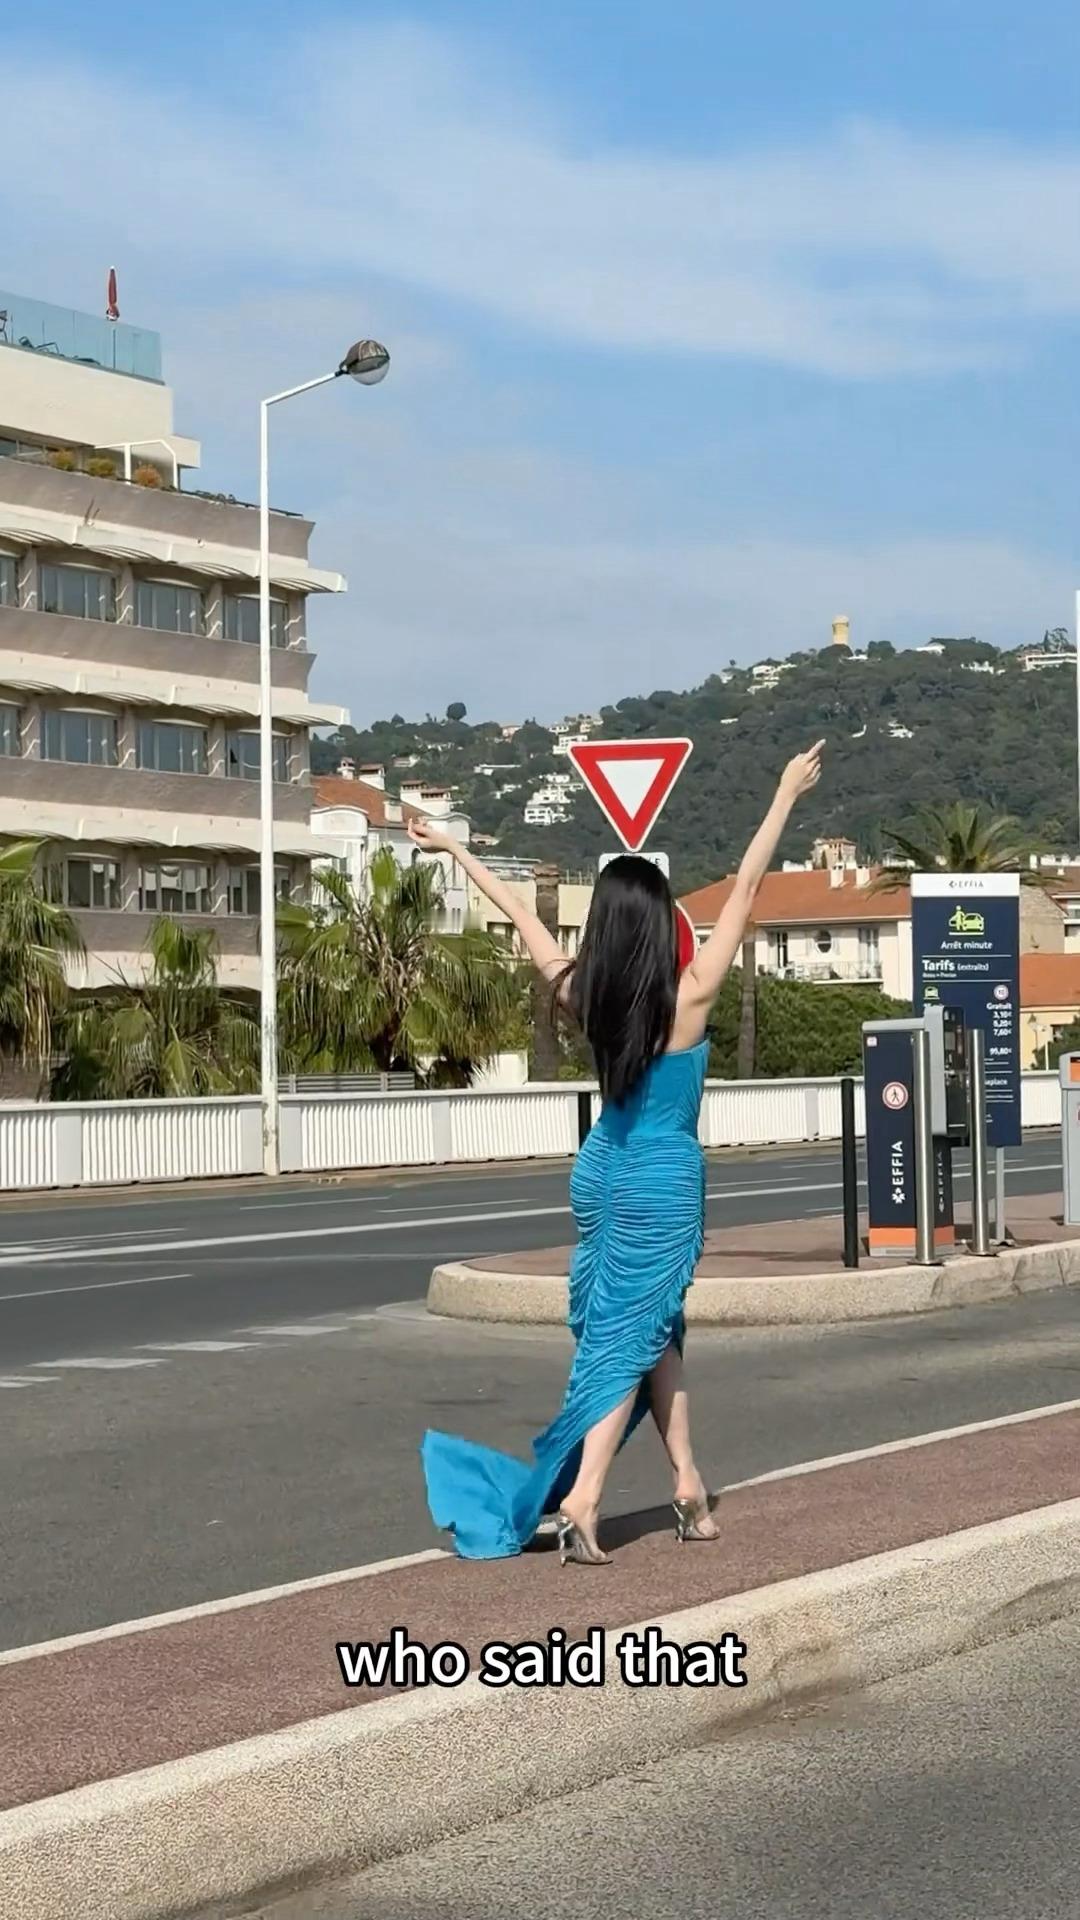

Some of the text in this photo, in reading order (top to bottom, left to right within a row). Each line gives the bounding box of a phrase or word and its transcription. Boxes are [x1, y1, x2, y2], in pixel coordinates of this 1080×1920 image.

[941, 941, 993, 949] Arrêt minute
[922, 960, 989, 971] Tarifs (extraits)
[891, 1140, 904, 1186] EFFIA
